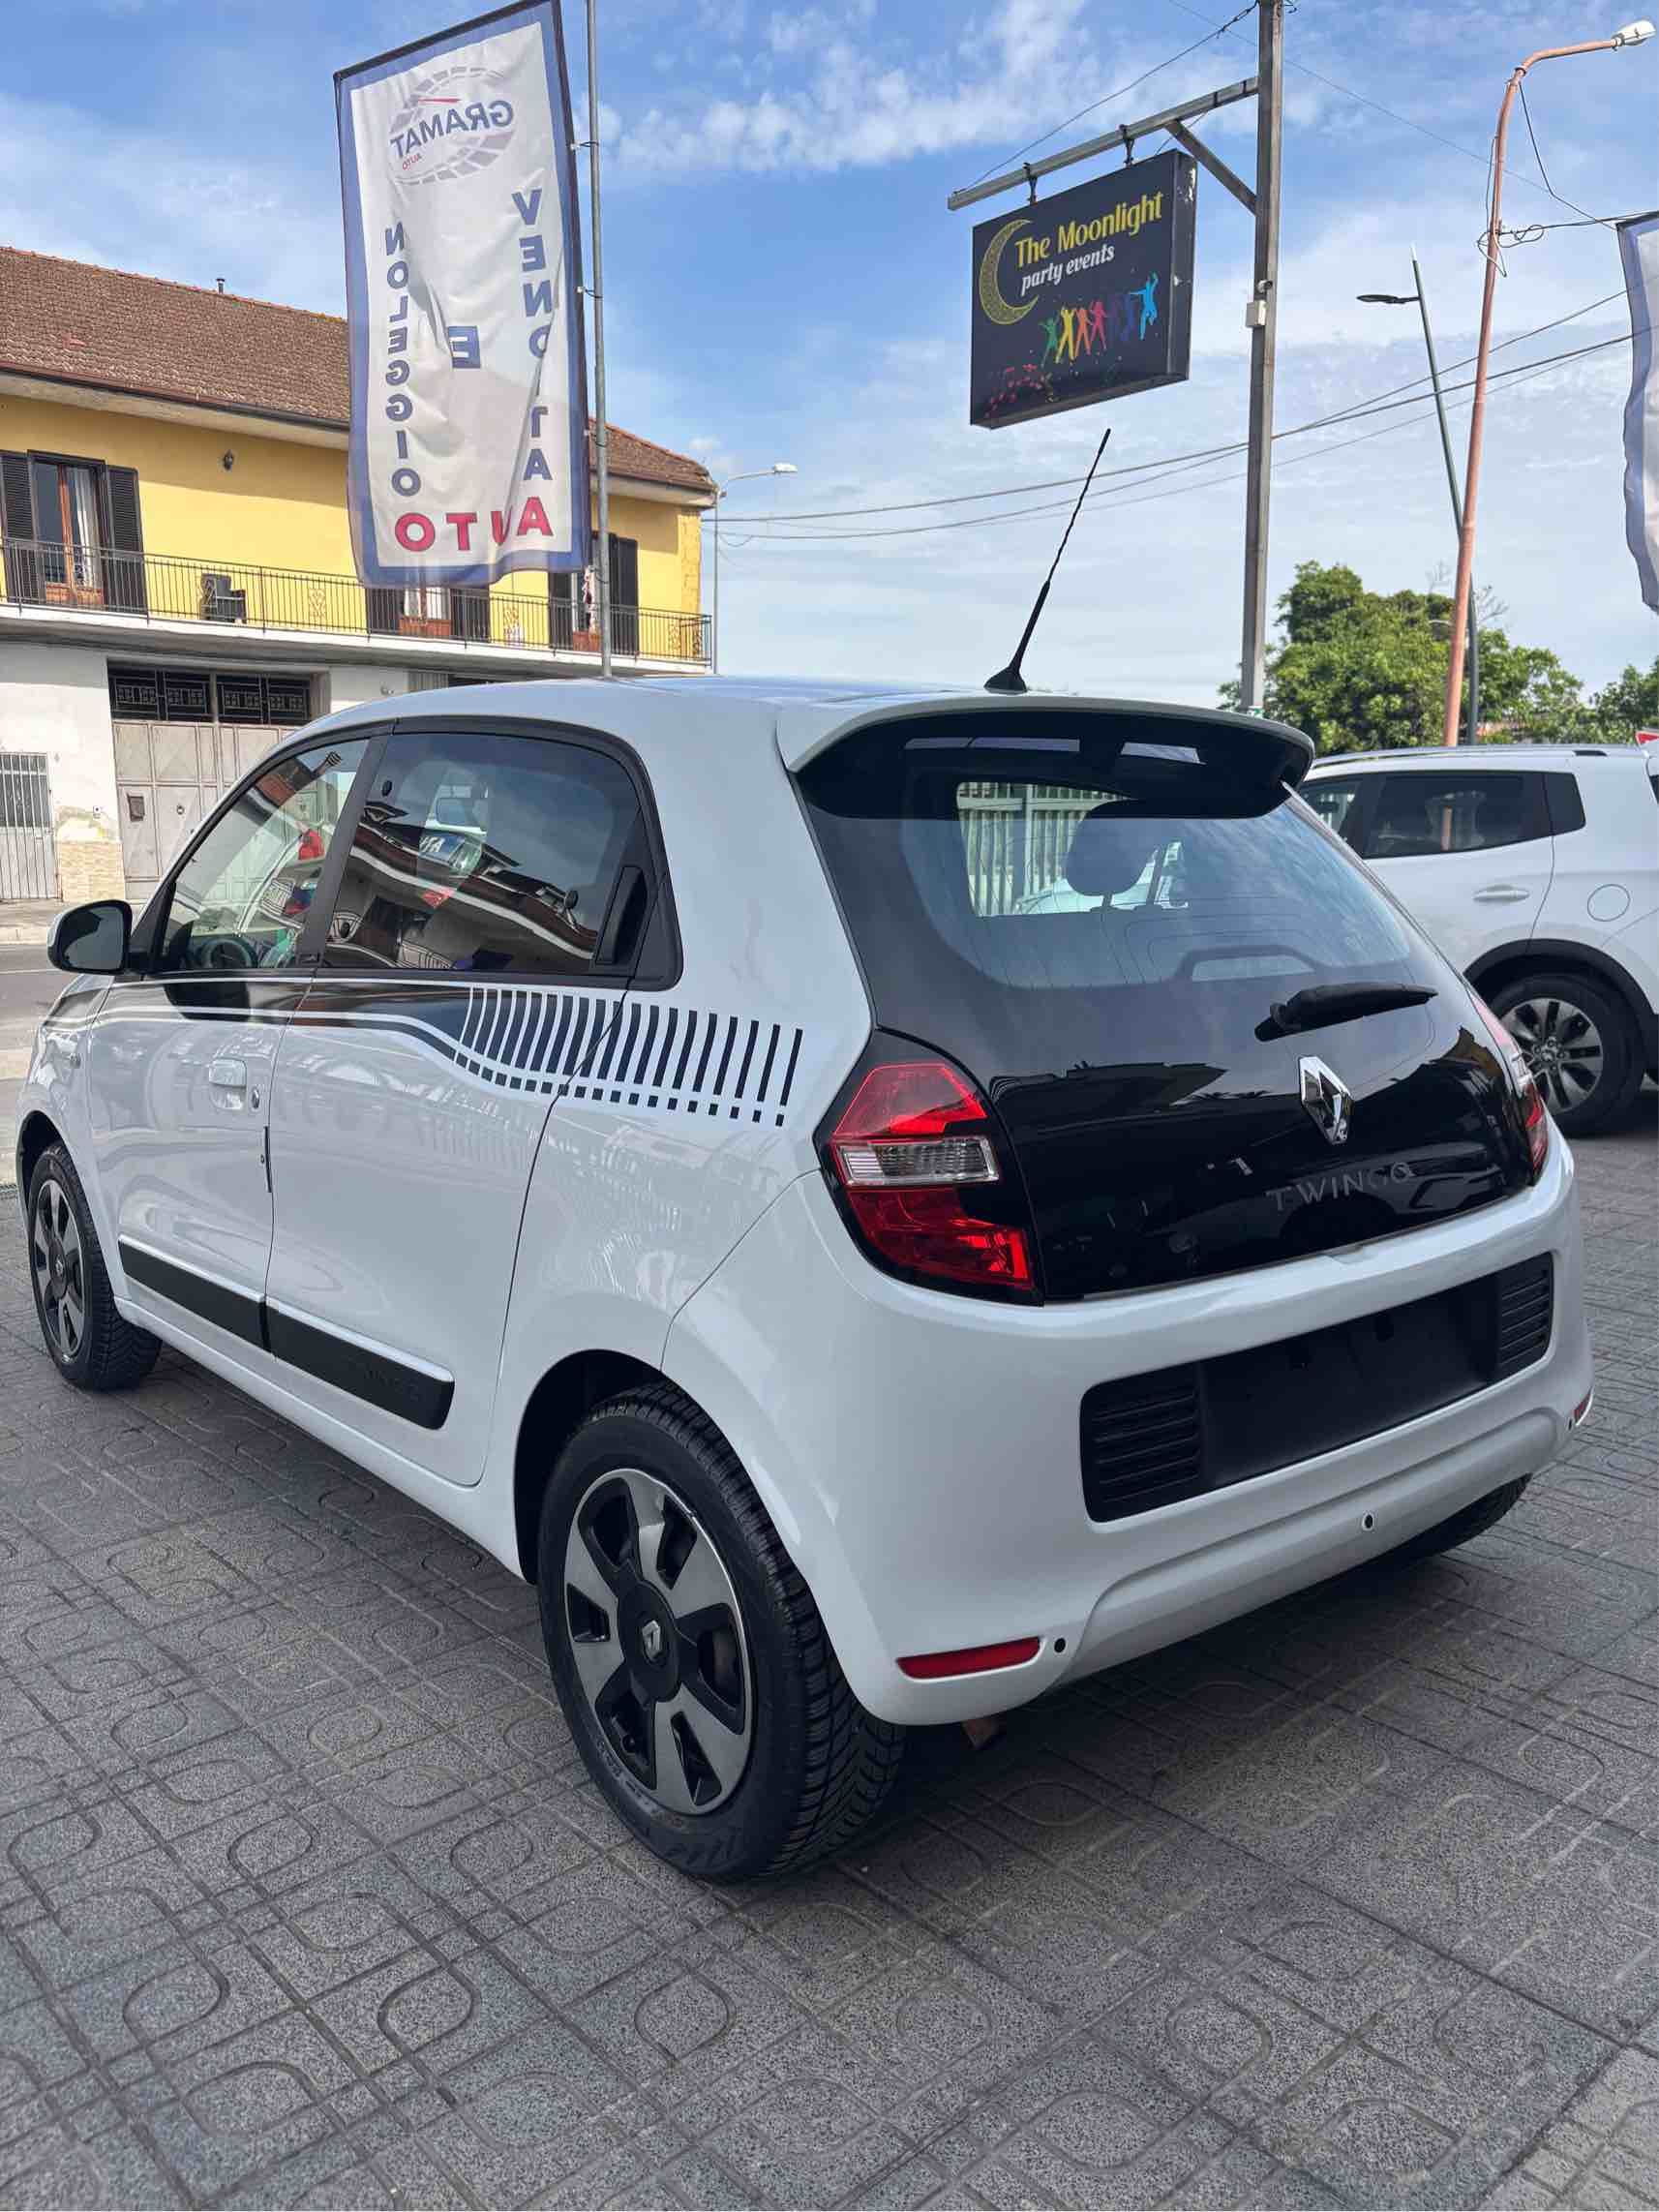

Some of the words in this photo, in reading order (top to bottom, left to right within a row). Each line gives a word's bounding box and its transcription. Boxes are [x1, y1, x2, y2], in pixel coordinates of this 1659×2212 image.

[1014, 235, 1050, 268] The
[1058, 192, 1163, 254] Moonlight
[1021, 262, 1063, 296] party
[1066, 244, 1115, 275] events
[1264, 1162, 1411, 1211] TWINGO
